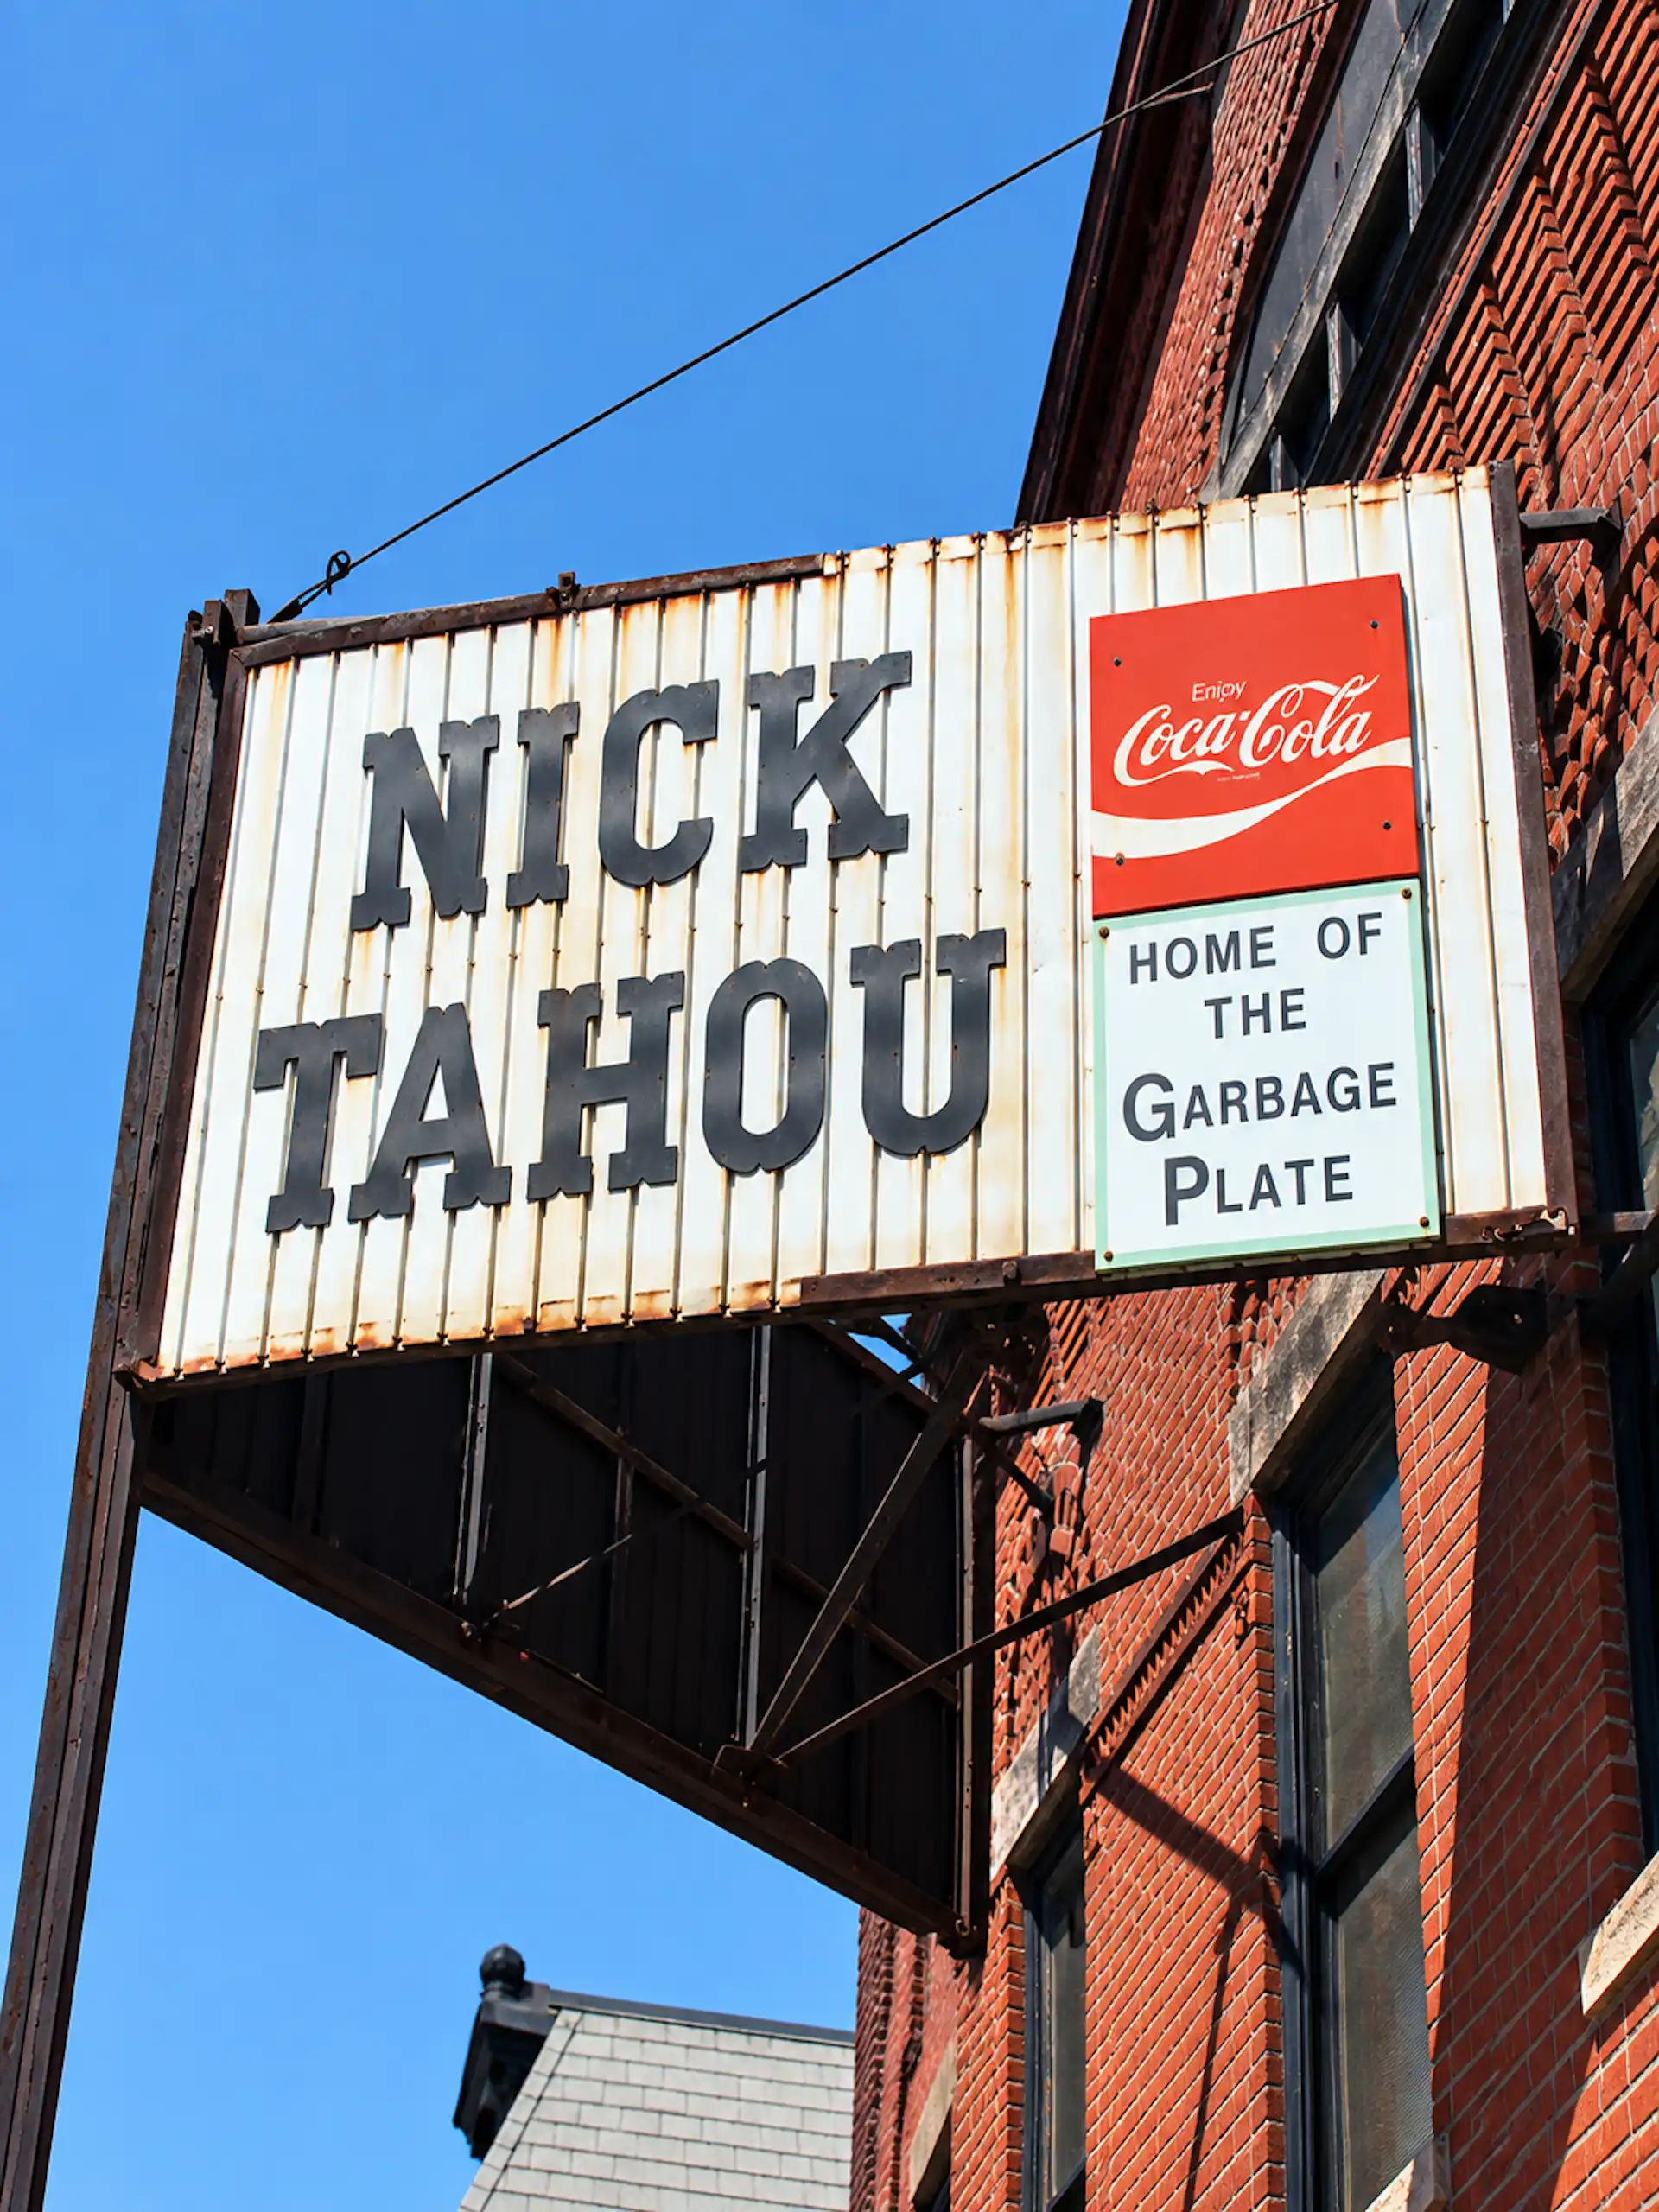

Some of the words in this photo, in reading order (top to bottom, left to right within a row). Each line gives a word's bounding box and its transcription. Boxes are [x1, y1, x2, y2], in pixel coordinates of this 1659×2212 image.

[1192, 680, 1247, 703] Enjoy
[1113, 674, 1380, 787] Coca-Cola
[350, 651, 912, 931] NICK
[1129, 925, 1276, 984] HOME
[1317, 912, 1382, 959] OF
[1205, 988, 1306, 1039] THE
[254, 928, 1006, 1232] TAHOU
[1122, 1062, 1397, 1141] GARBAGE
[1164, 1154, 1353, 1226] PLATE
